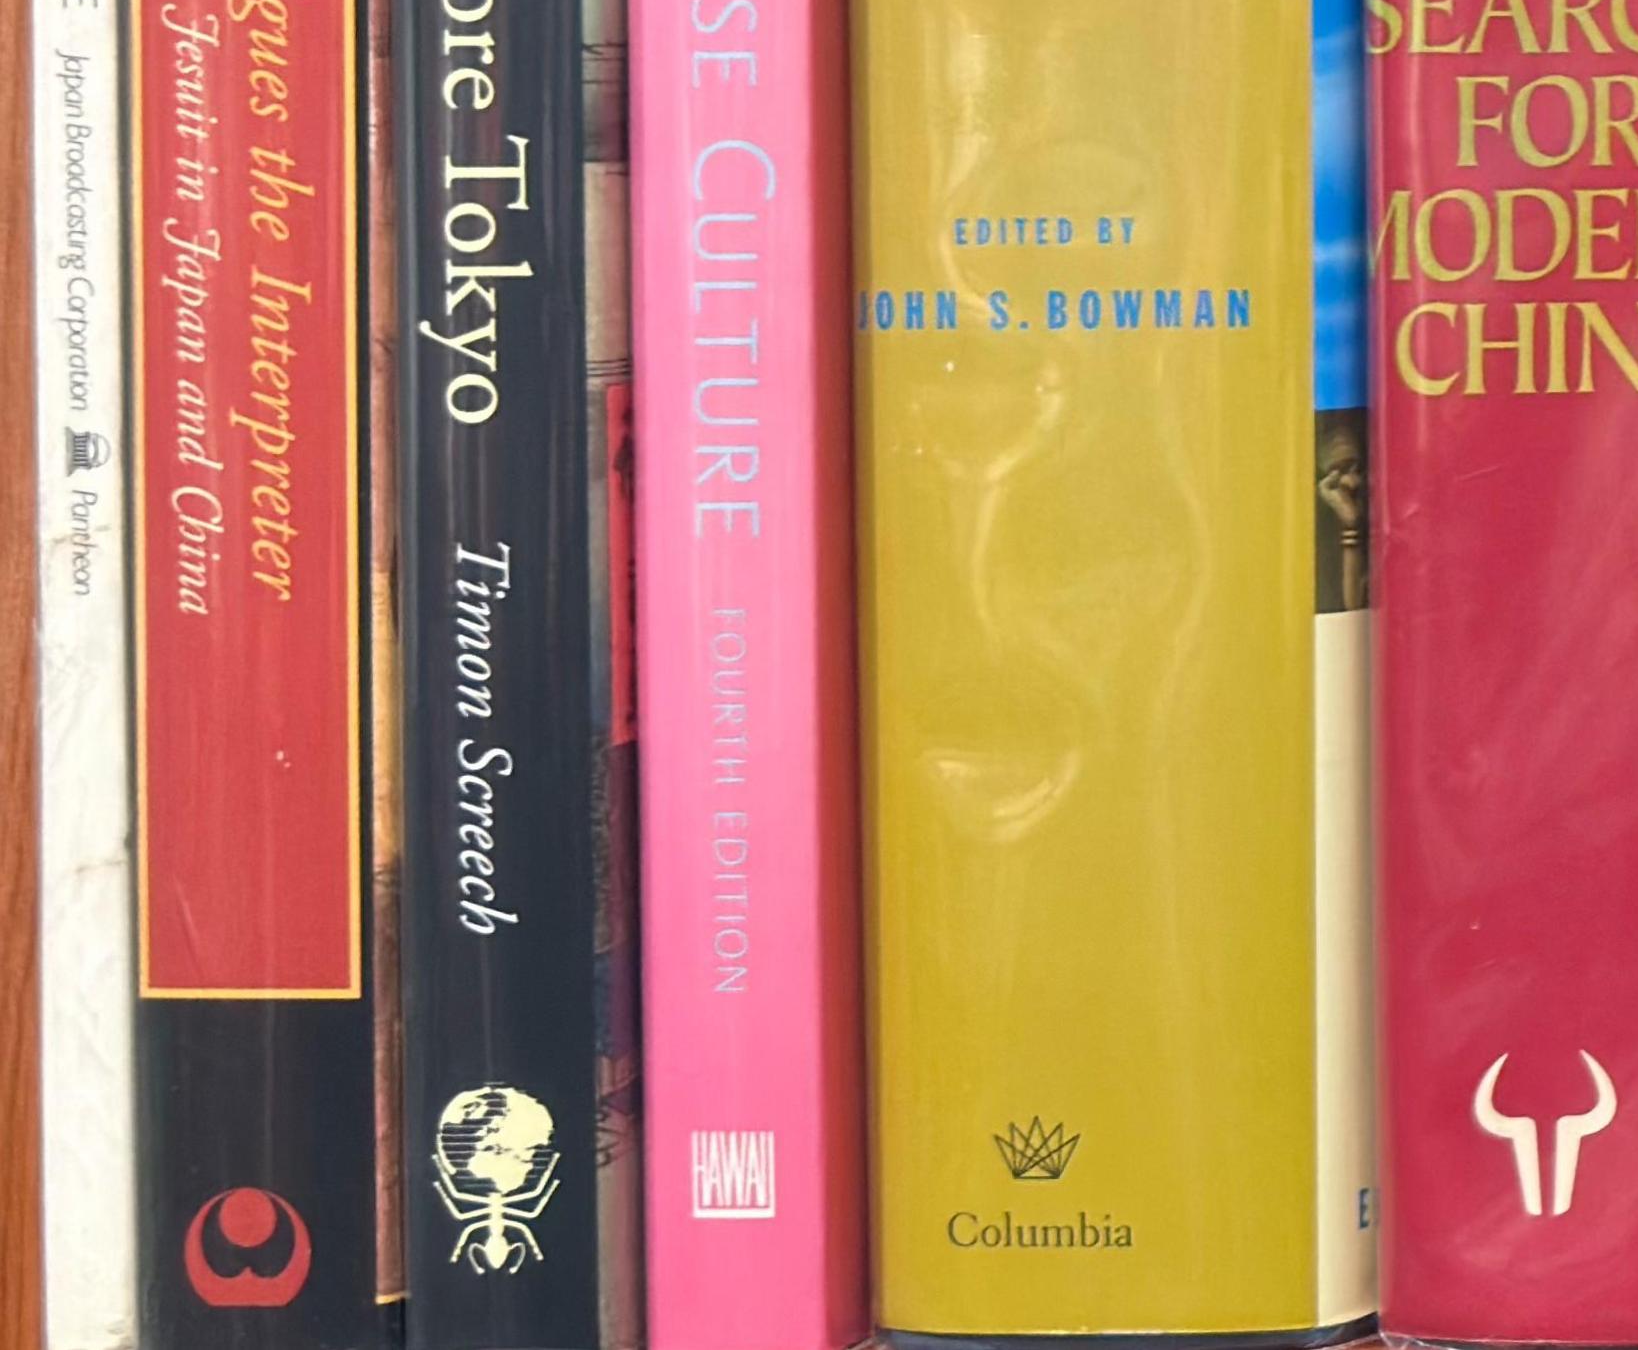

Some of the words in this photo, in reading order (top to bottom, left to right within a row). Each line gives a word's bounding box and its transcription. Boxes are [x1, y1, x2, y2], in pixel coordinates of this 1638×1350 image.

[56, 48, 90, 120] Japan
[161, 3, 220, 138] Jesuit
[58, 125, 93, 270] Broadcasting
[176, 155, 219, 201] in
[249, 146, 315, 241] the
[954, 217, 1073, 245] EDITED
[1097, 217, 1135, 245] BY
[65, 276, 96, 412] Corporation
[162, 217, 221, 364] Japan
[417, 136, 534, 426] Tokyo
[690, 139, 776, 539] CULTURE
[989, 290, 1029, 331] S.
[1047, 289, 1252, 329] BOWMAN
[177, 380, 224, 470] and
[230, 265, 312, 603] Interpreter
[69, 489, 99, 597] Pantheon
[172, 487, 224, 616] China
[451, 541, 512, 720] Timon
[710, 607, 750, 786] FOURTH
[455, 738, 519, 937] Screech
[713, 810, 750, 996] EDITION
[947, 1211, 1133, 1249] Columbia
